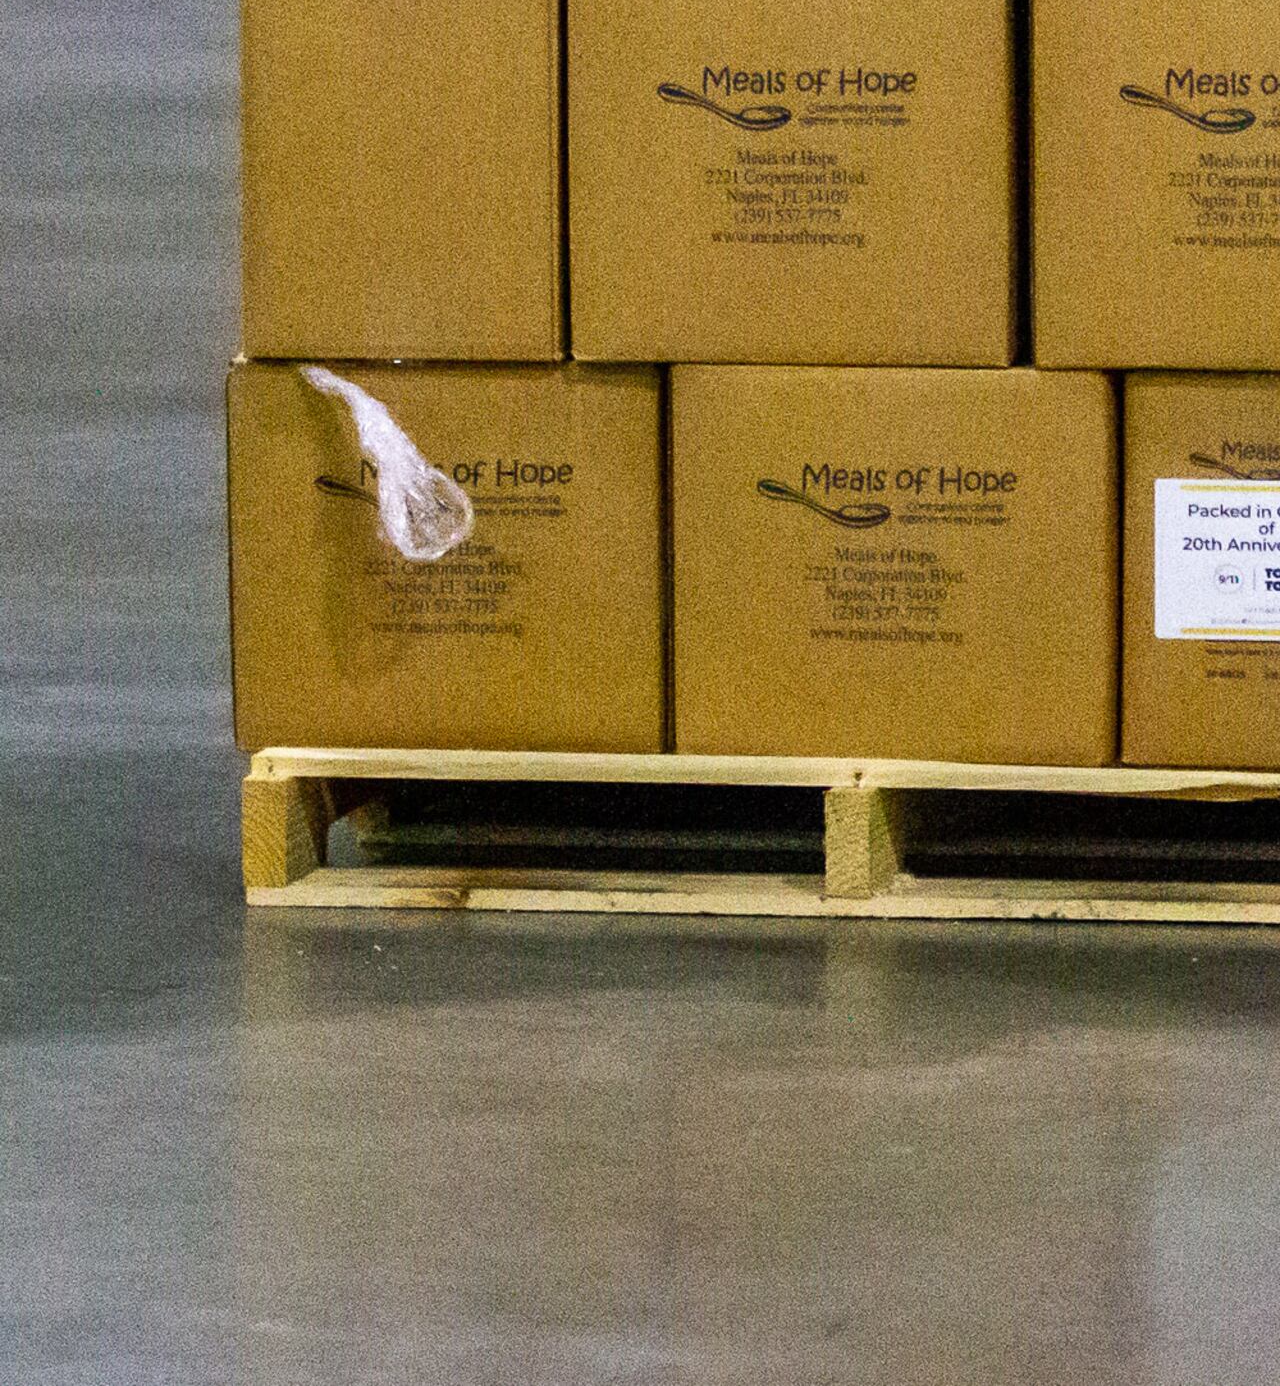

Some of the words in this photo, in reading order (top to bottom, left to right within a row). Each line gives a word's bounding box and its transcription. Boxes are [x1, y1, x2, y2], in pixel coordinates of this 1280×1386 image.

[701, 66, 787, 97] Meals
[794, 68, 831, 97] of
[838, 67, 918, 97] Hope
[1164, 67, 1252, 99] Meals
[452, 460, 487, 488] of
[495, 458, 574, 488] Hope
[801, 464, 885, 493] Meals
[894, 466, 931, 495] of
[938, 466, 1018, 497] Hope
[1187, 503, 1252, 519] Packed
[1255, 507, 1273, 519] in
[1258, 521, 1276, 536] of
[1182, 536, 1223, 552] 20th
[1217, 574, 1240, 585] 9/11
